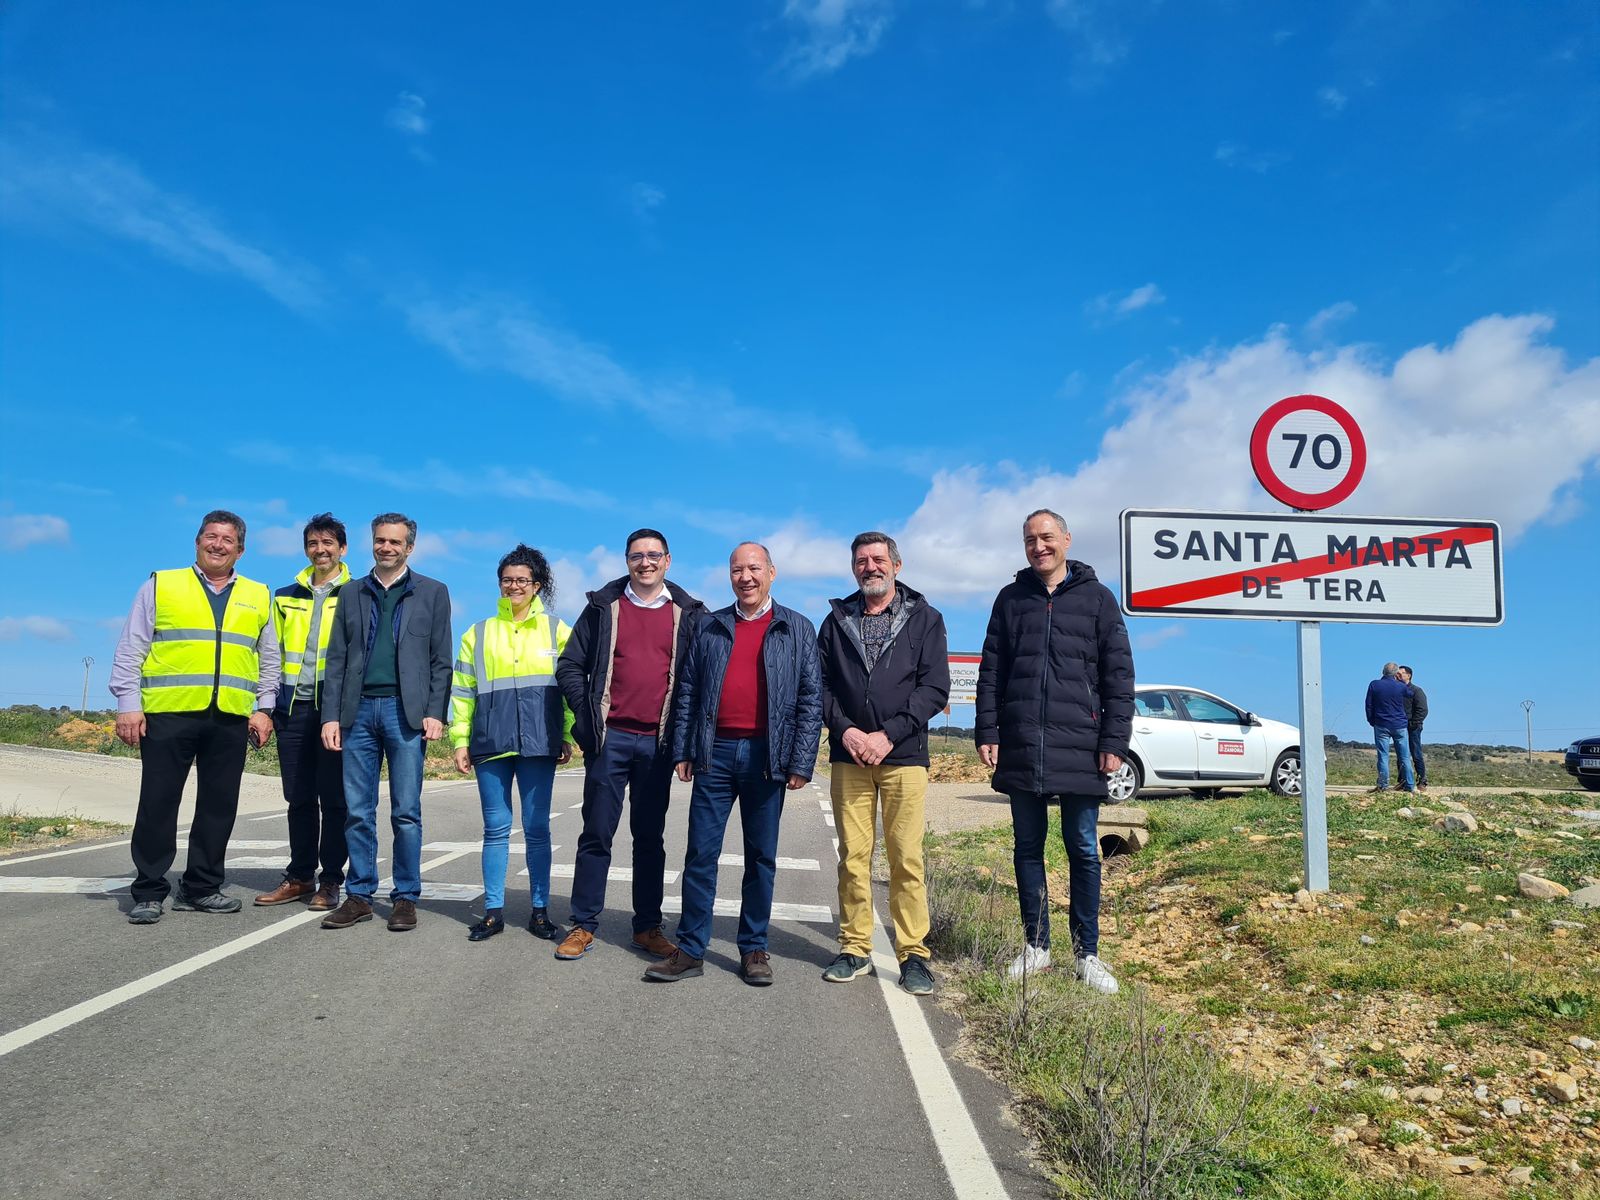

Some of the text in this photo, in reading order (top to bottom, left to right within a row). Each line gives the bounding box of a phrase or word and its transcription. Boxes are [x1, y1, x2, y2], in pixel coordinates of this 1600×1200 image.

[1282, 433, 1342, 470] 70
[1153, 529, 1472, 569] SANTA MARTA
[1242, 575, 1386, 603] DE TERA
